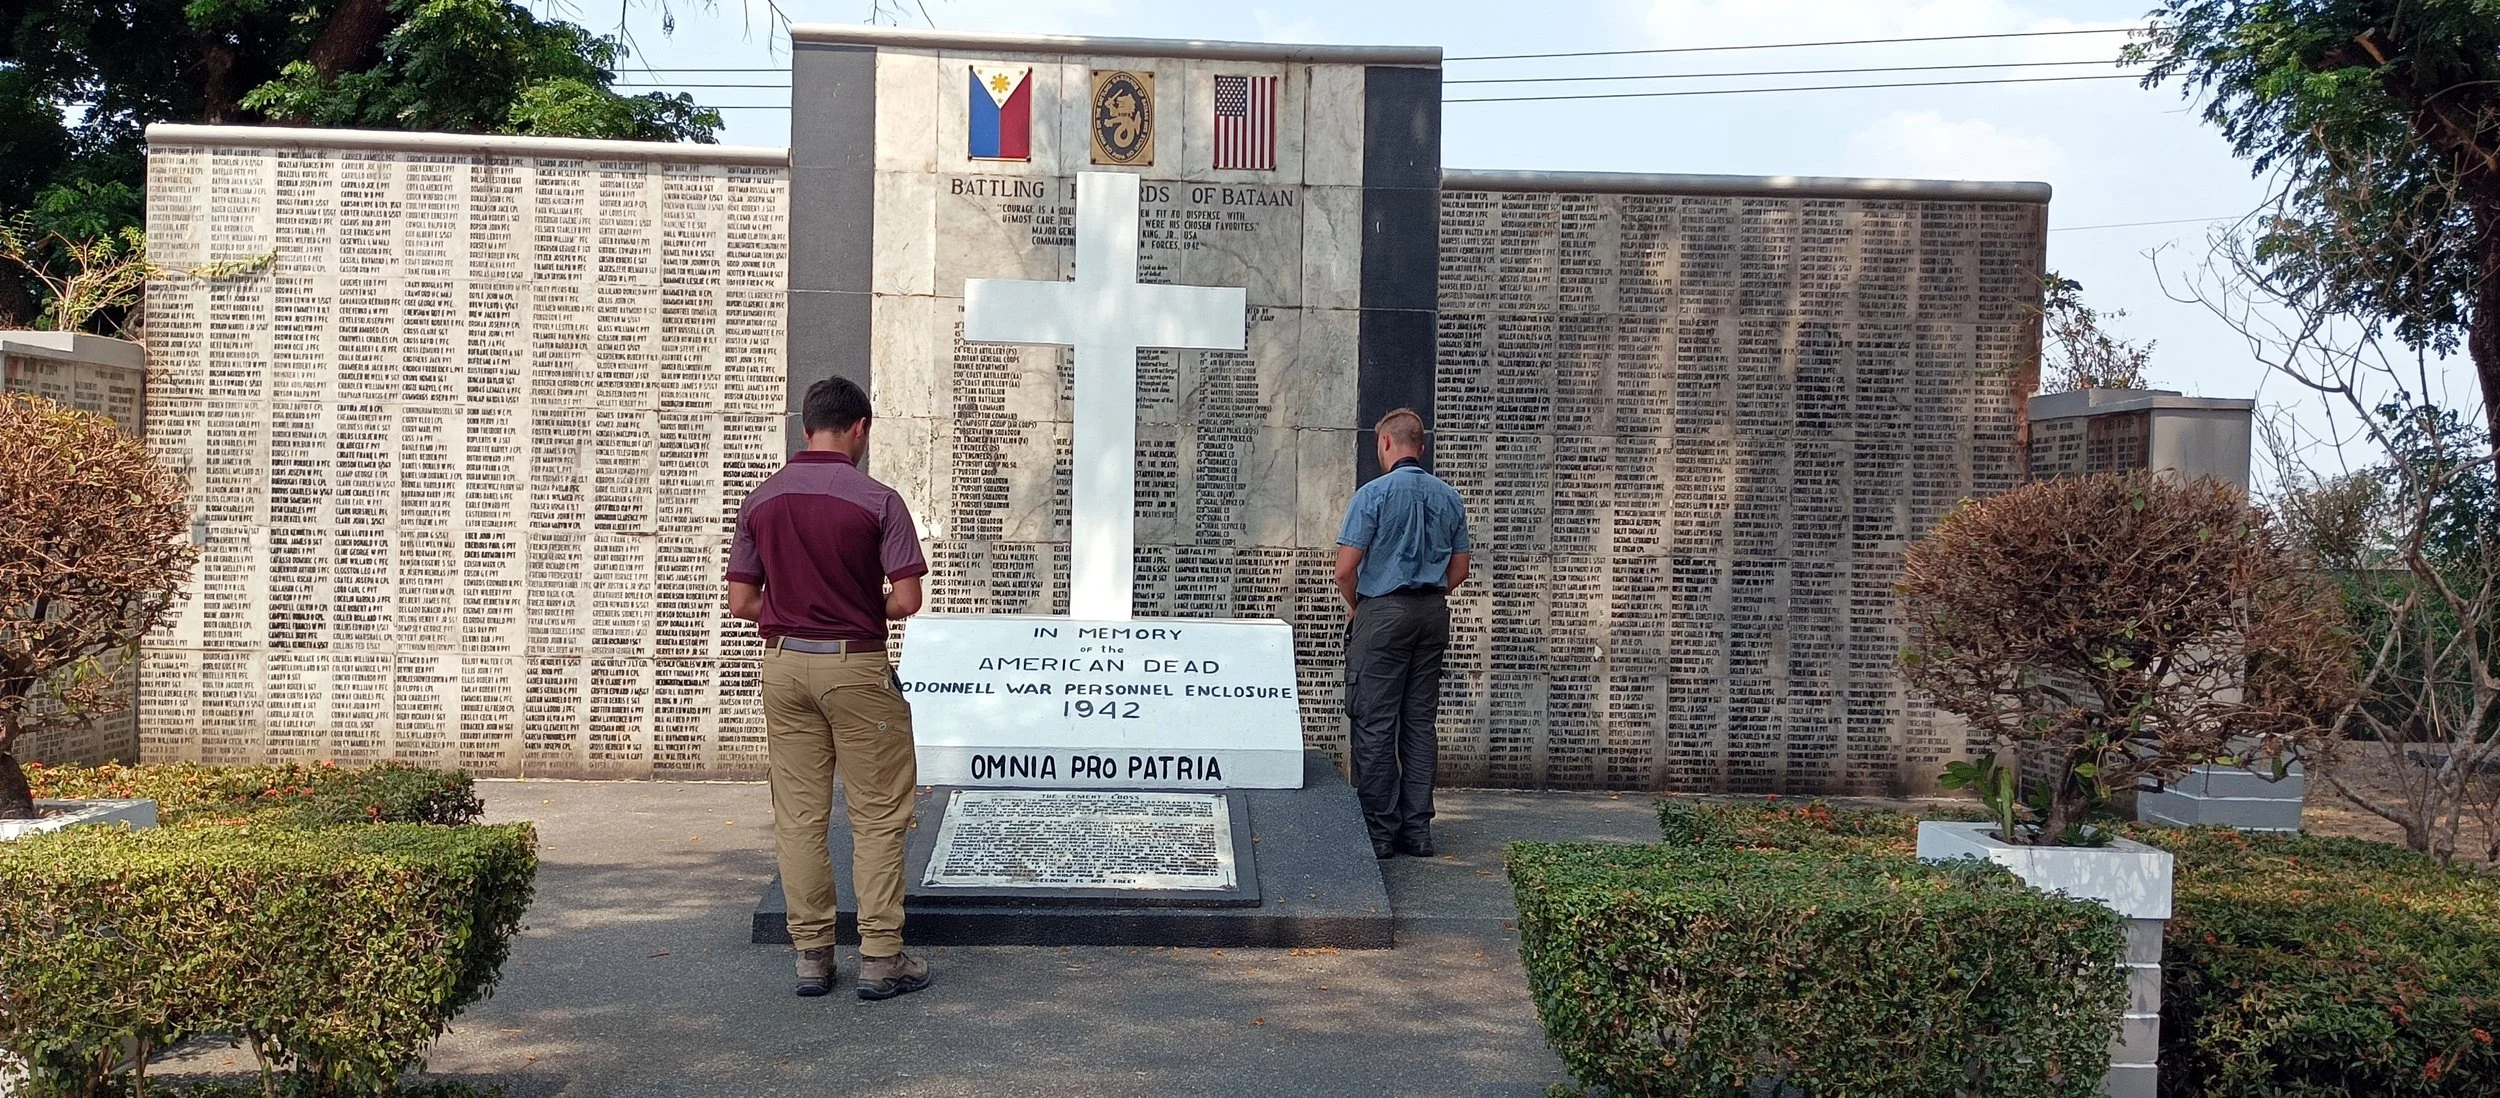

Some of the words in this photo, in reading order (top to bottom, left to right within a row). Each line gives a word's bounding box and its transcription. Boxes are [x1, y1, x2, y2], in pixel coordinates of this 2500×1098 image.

[951, 179, 1044, 198] BATTLING
[1192, 188, 1216, 204] OF
[1222, 189, 1293, 206] BATAAN
[1003, 215, 1031, 224] UTMOST
[1060, 217, 1072, 226] THE
[1146, 220, 1164, 228] WERE
[1184, 221, 1211, 230] CHOSEN
[1187, 211, 1220, 220] DISPENSE
[1227, 212, 1245, 221] WITH
[1032, 226, 1056, 235] MAJOR
[1059, 227, 1076, 236] GENE
[1032, 236, 1076, 246] COMMANDIN
[1152, 242, 1180, 250] FORCES,
[1033, 627, 1058, 638] IN
[1079, 627, 1182, 641] MEMORY
[978, 657, 1124, 672] AMERICAN
[1144, 660, 1220, 674] DEAD
[900, 681, 995, 694] ODONNELL
[1007, 684, 1051, 694] WAR
[1065, 683, 1174, 697] PERSONNEL
[1186, 685, 1292, 699] ENCLOSURE
[1063, 699, 1140, 720] 1942
[971, 754, 1056, 780] OMNIA
[1072, 755, 1117, 779] PRO
[1128, 756, 1222, 781] PATRIA
